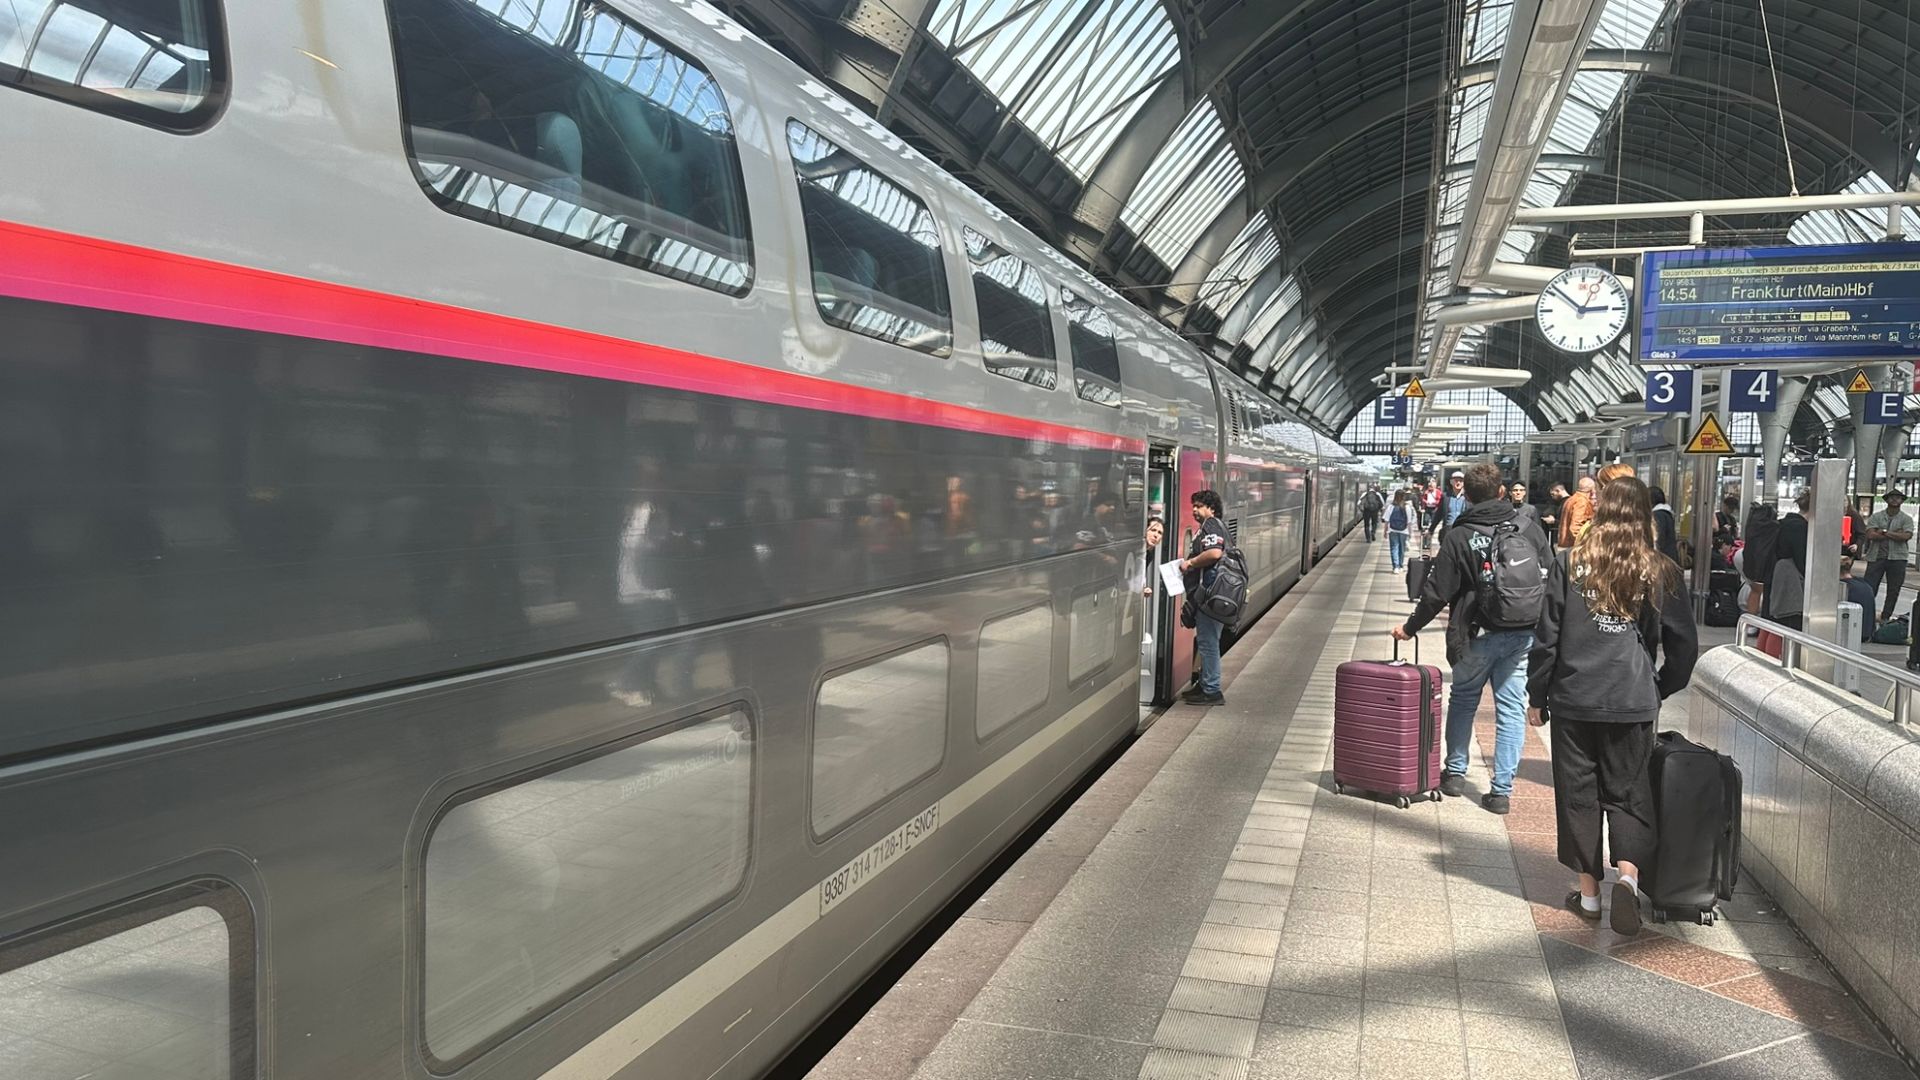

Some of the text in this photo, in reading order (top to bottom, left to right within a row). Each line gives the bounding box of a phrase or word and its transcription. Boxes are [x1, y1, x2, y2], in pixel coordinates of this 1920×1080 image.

[1732, 276, 1769, 284] Mannheim
[1771, 275, 1784, 283] Hbf
[1659, 282, 1874, 301] 14:54 Frankfurt(Main)Hbf
[1749, 326, 1786, 334] Mannheim
[1730, 335, 1742, 343] ICE
[1744, 335, 1754, 343] 72
[1760, 334, 1792, 343] Hamburg
[1794, 334, 1808, 342] Hbf
[1828, 333, 1866, 341] Mannheim
[1651, 351, 1670, 359] Gleis
[1652, 372, 1675, 403] 3
[1747, 371, 1770, 402] 4
[1380, 398, 1395, 419] E
[1881, 393, 1899, 416] E
[1392, 455, 1398, 464] 3
[1403, 456, 1410, 464] D
[1204, 533, 1218, 546] 53
[824, 806, 937, 905] 9387 314 7128-1 F-SNCF
